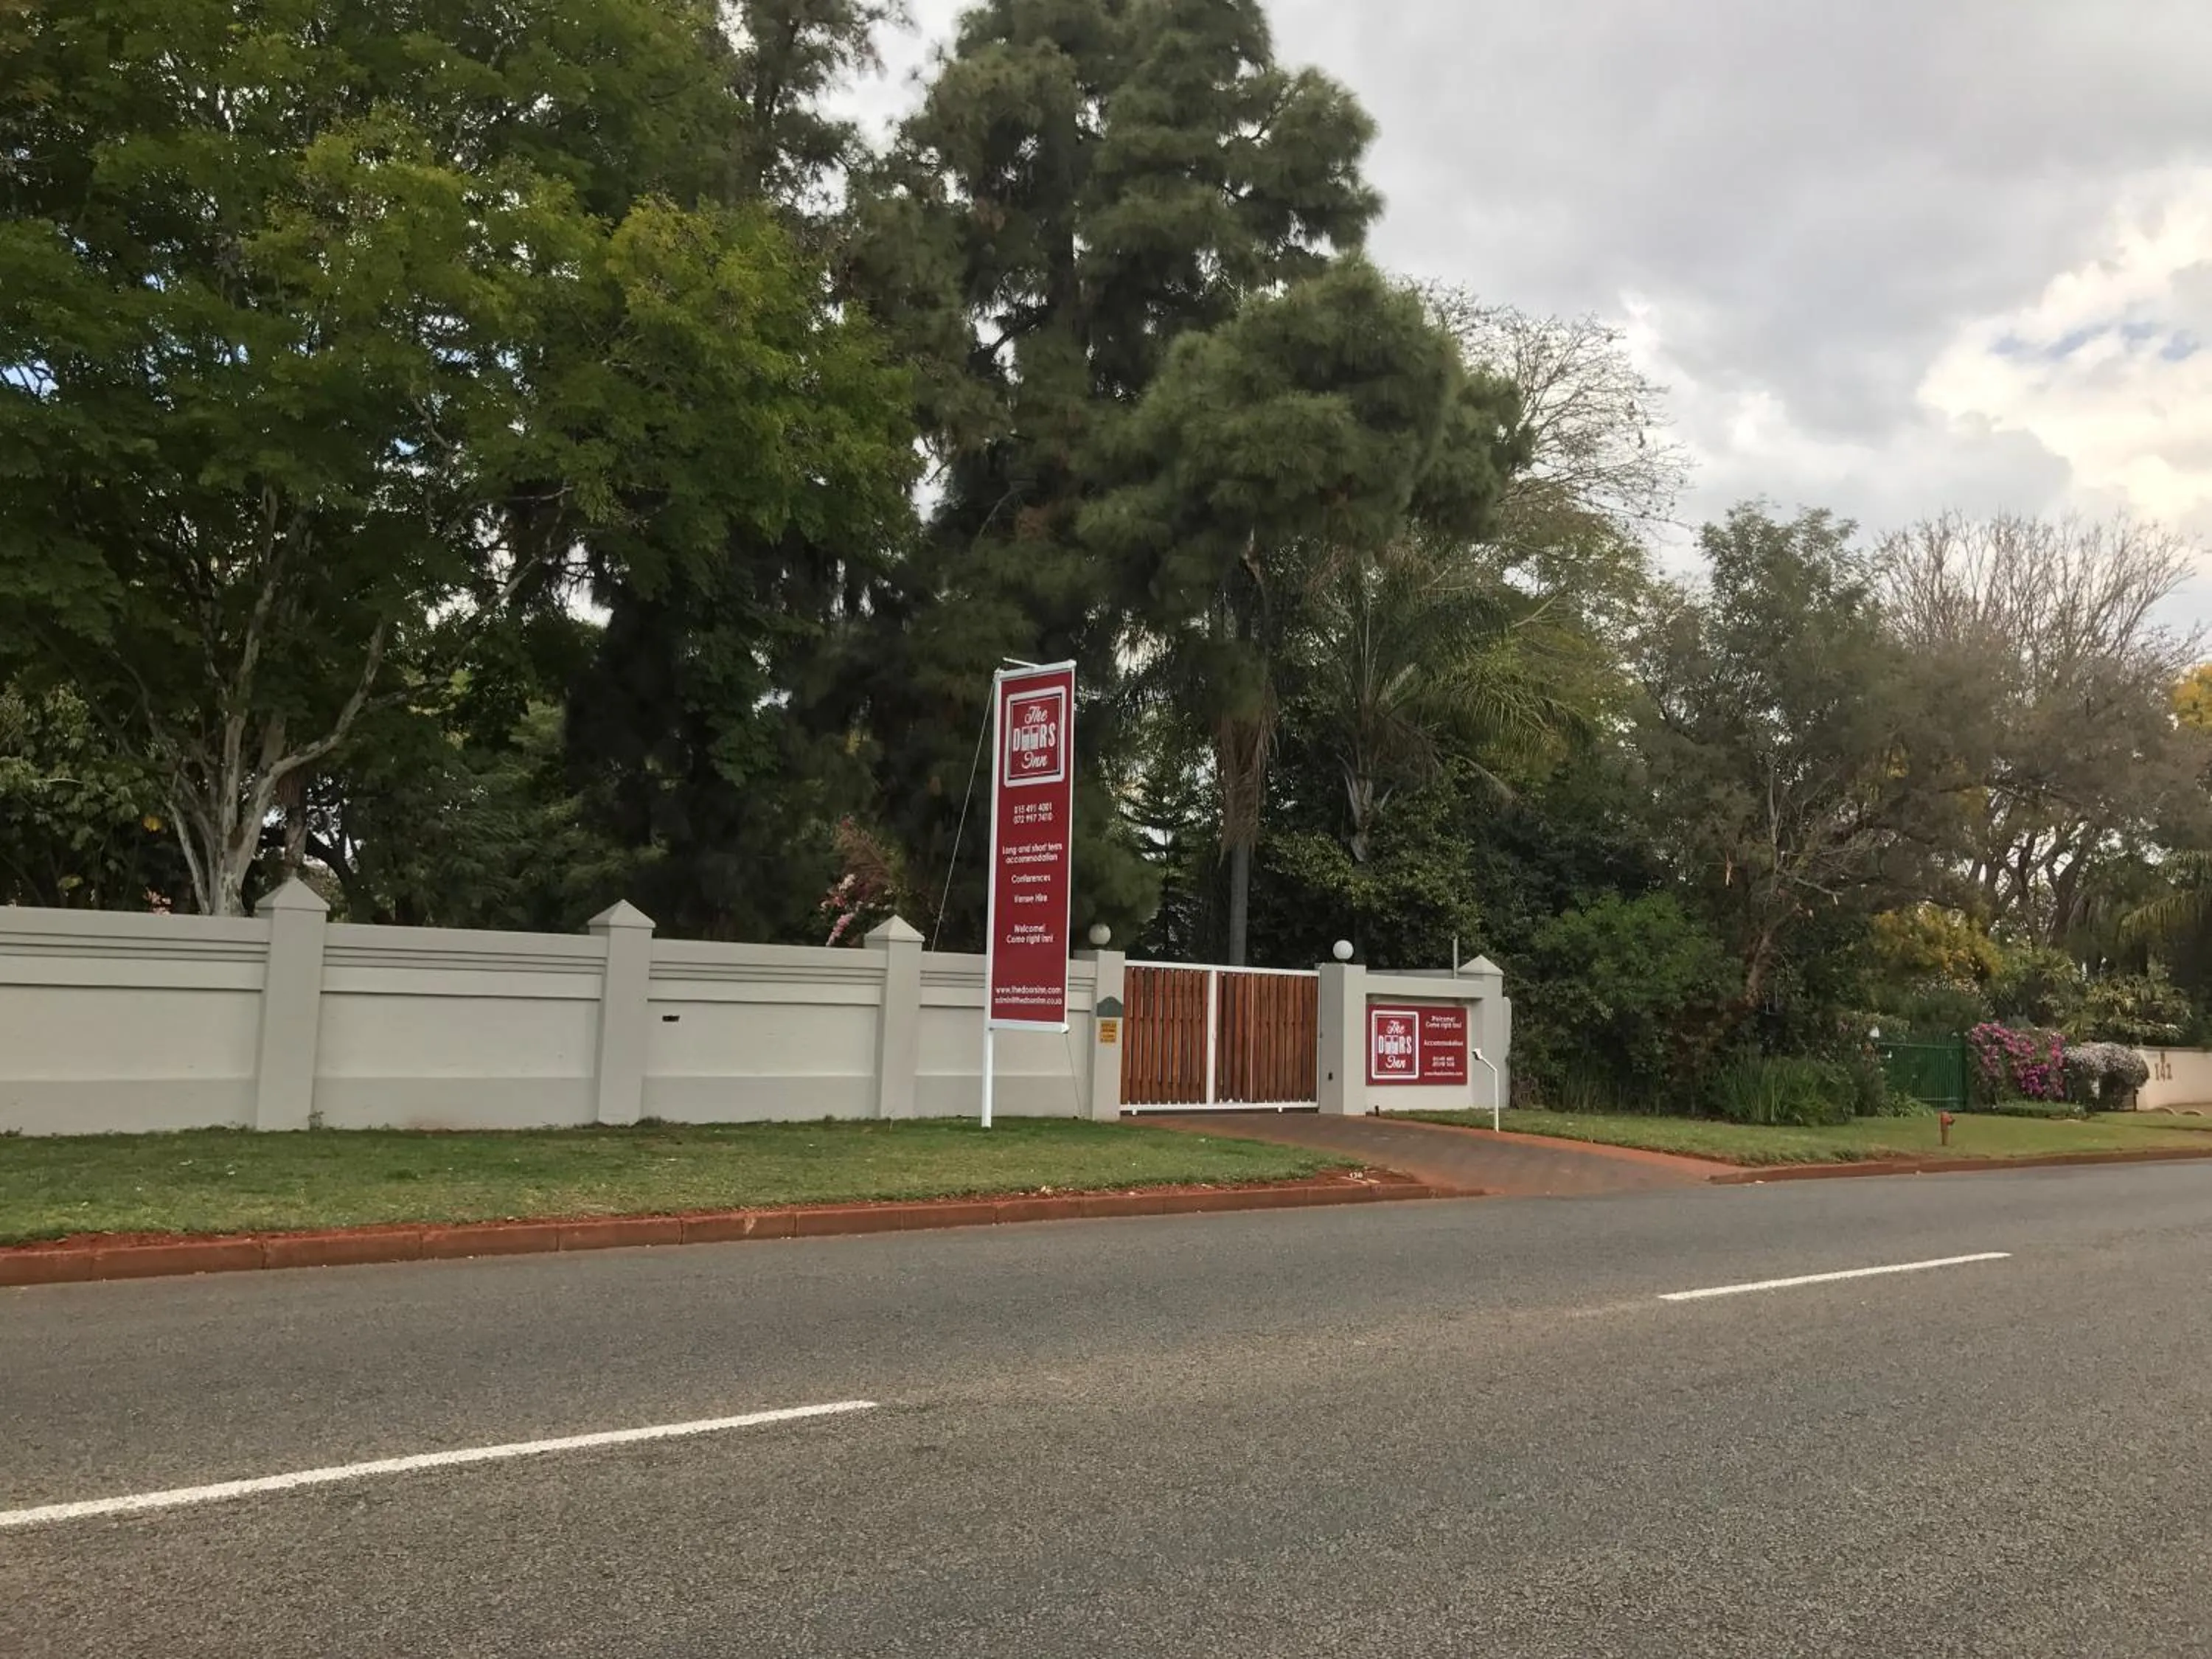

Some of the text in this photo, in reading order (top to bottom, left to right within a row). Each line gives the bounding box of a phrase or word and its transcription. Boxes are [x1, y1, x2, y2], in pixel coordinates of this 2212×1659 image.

[1024, 706, 1048, 724] The
[1012, 722, 1056, 751] DOORS
[1021, 751, 1048, 769] Inn
[1018, 844, 1031, 853] and
[1005, 852, 1058, 864] accommodation
[1006, 934, 1025, 944] Come
[1026, 934, 1040, 944] right
[1386, 1020, 1405, 1034] The
[1378, 1034, 1412, 1054] DOORS
[1385, 1055, 1406, 1068] Inn
